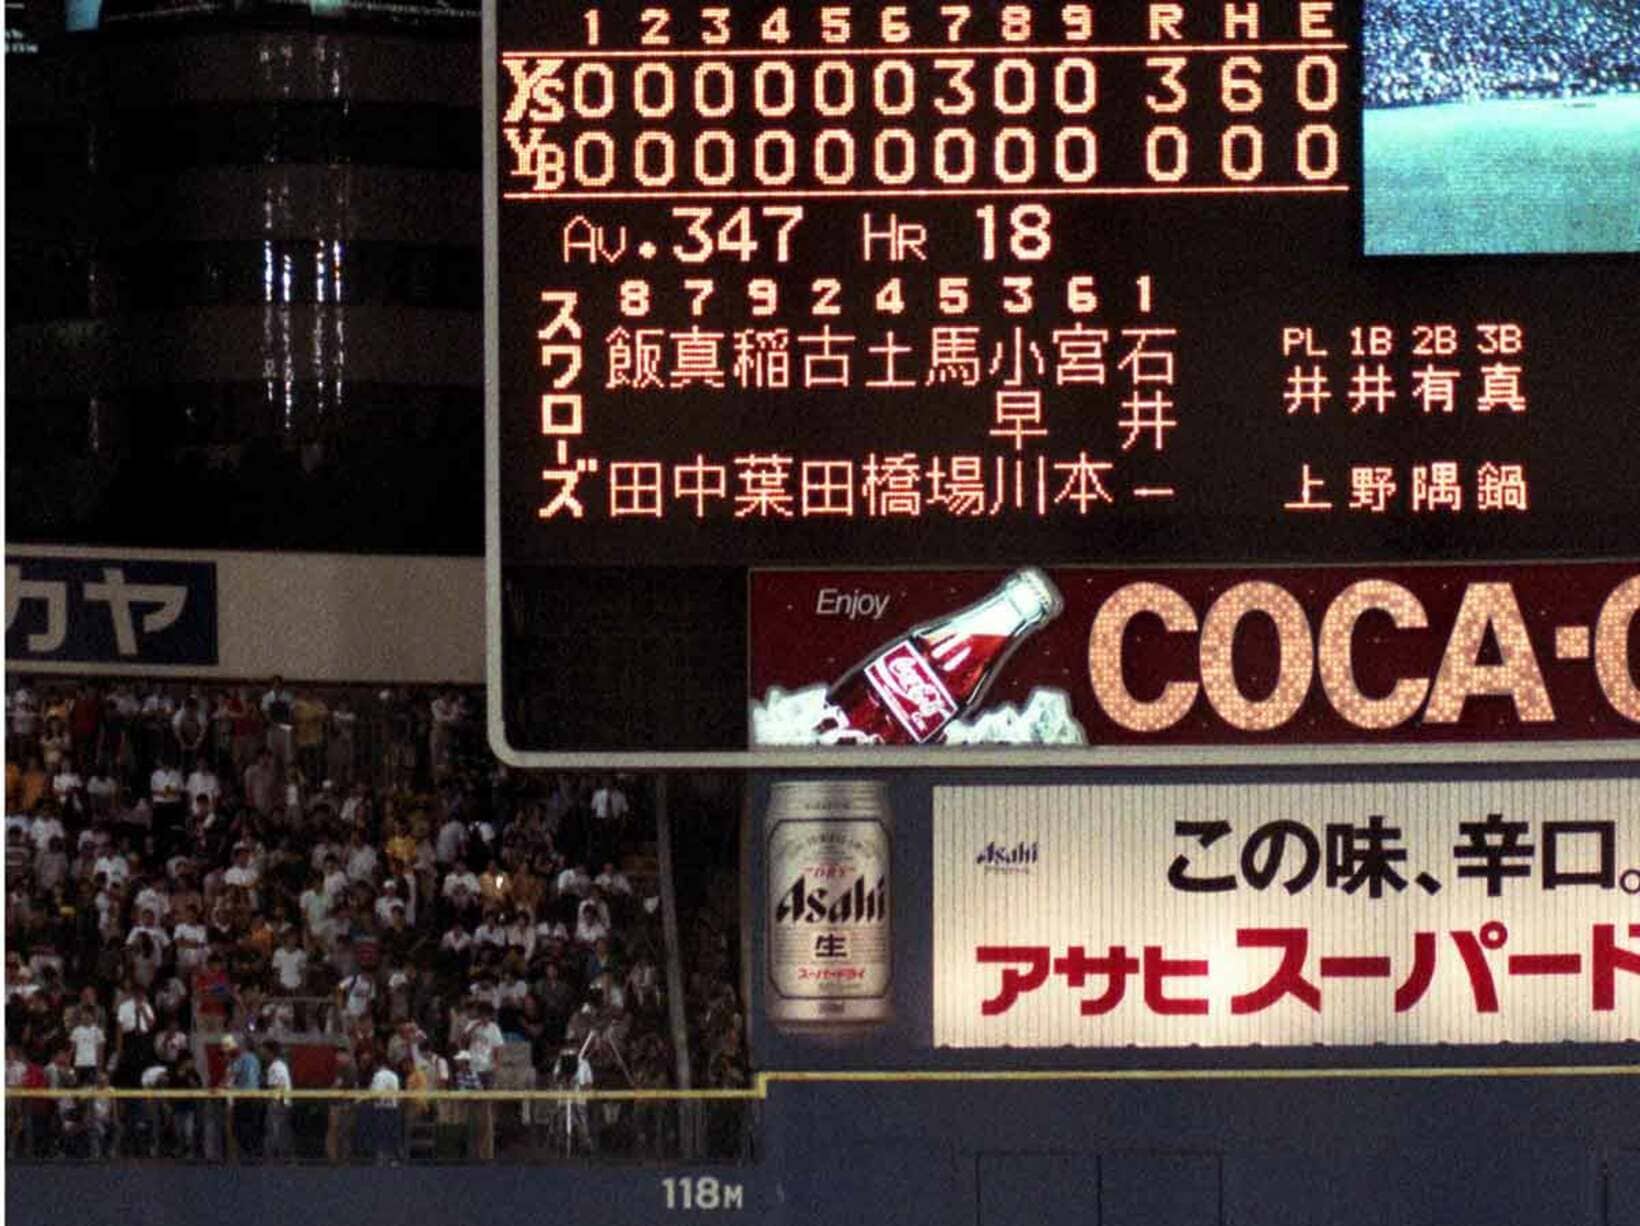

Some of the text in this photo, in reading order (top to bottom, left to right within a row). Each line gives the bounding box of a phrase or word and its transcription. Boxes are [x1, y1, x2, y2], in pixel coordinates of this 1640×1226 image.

[584, 3, 1334, 45] 1 2 3 4 5 6 7 8 9 R H E
[574, 62, 614, 117] 0
[634, 62, 674, 117] 0
[695, 62, 734, 117] 0
[755, 61, 795, 117] 0
[814, 60, 854, 116] 0
[874, 60, 914, 115] 0
[934, 59, 975, 115] 3
[994, 58, 1035, 114] 0
[1055, 57, 1096, 114] 0
[1147, 57, 1186, 112] 3
[1222, 56, 1262, 112] 6
[1297, 56, 1337, 111] 0
[574, 132, 614, 186] 0
[635, 131, 675, 186] 0
[695, 131, 735, 186] 0
[756, 131, 796, 186] 0
[816, 130, 855, 186] 0
[876, 130, 916, 185] 0
[935, 129, 976, 185] 0
[996, 128, 1036, 184] 0
[1056, 128, 1097, 183] 0
[1147, 127, 1189, 183] 0
[1223, 127, 1263, 182] 0
[1298, 125, 1339, 181] 0
[977, 204, 1051, 260] 18
[620, 276, 1151, 316] 8 7 9 2 4 5 3 6 1
[1283, 324, 1522, 357] PL 1B 2B 3B
[538, 291, 598, 518] スワローズ
[816, 588, 891, 621] Enjoy
[976, 841, 1038, 864] Asahi
[775, 874, 886, 924] Asahi
[815, 933, 848, 958] 生
